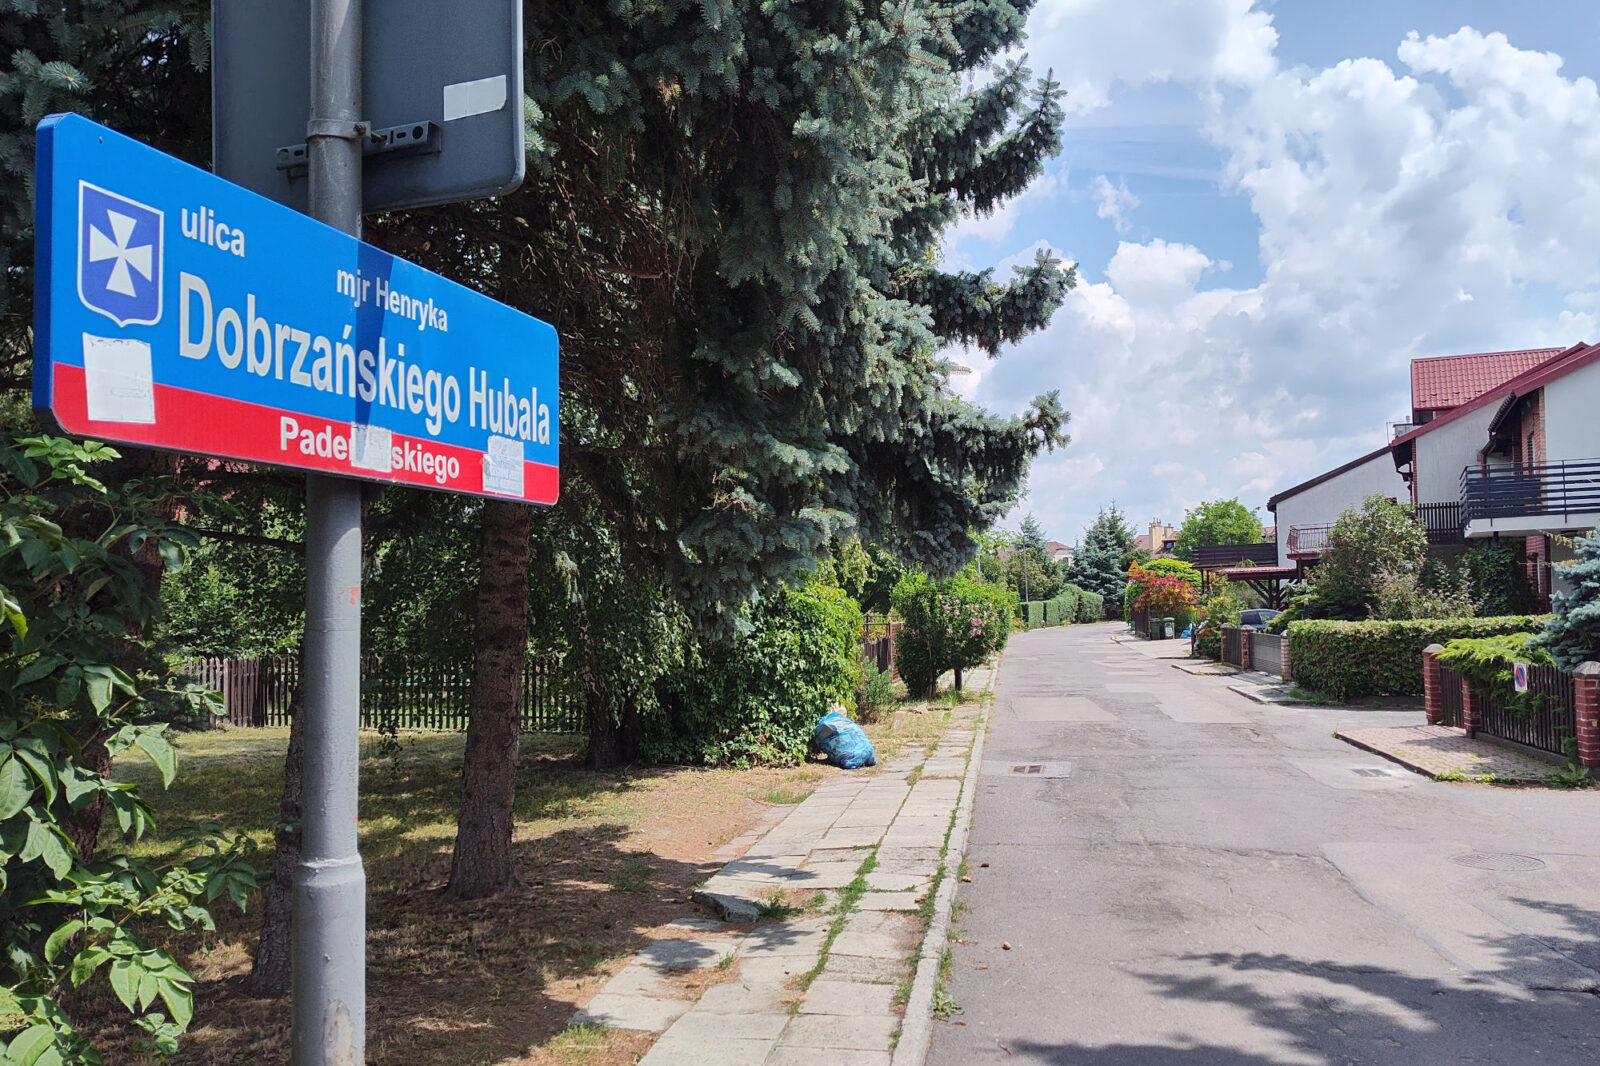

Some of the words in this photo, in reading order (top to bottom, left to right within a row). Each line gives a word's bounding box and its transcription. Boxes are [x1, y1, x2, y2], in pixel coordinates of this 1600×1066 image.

[181, 205, 245, 257] ulica
[336, 269, 370, 308] mjr
[375, 277, 448, 332] Henryka
[179, 271, 461, 436] Dobrzańskiego
[469, 366, 550, 445] Hubala
[280, 416, 460, 484] Padeskiego
